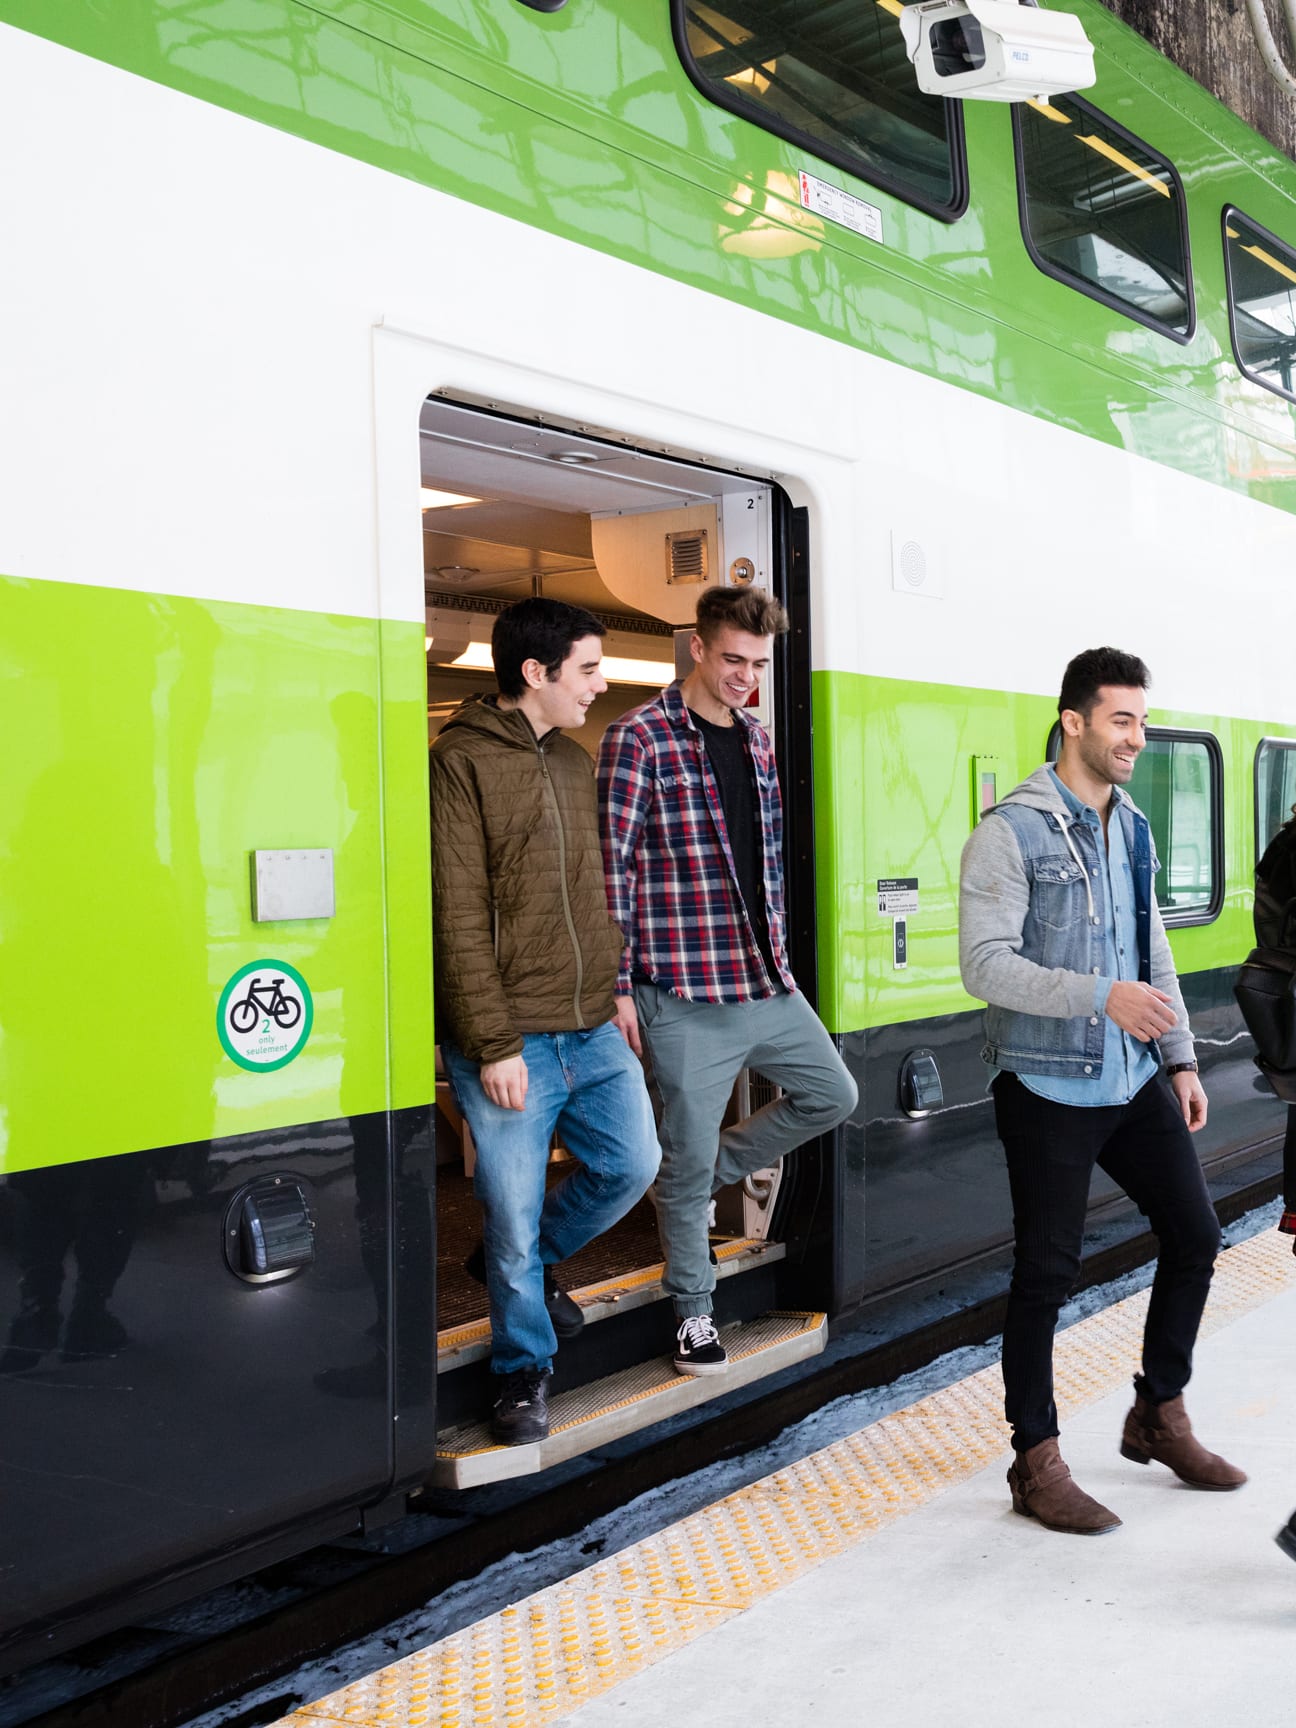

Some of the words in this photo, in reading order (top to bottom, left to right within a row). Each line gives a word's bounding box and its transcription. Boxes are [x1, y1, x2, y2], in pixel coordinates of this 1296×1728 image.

[747, 498, 754, 509] 2
[262, 1019, 271, 1033] 2
[258, 1035, 275, 1044] only
[246, 1044, 288, 1056] seulement
